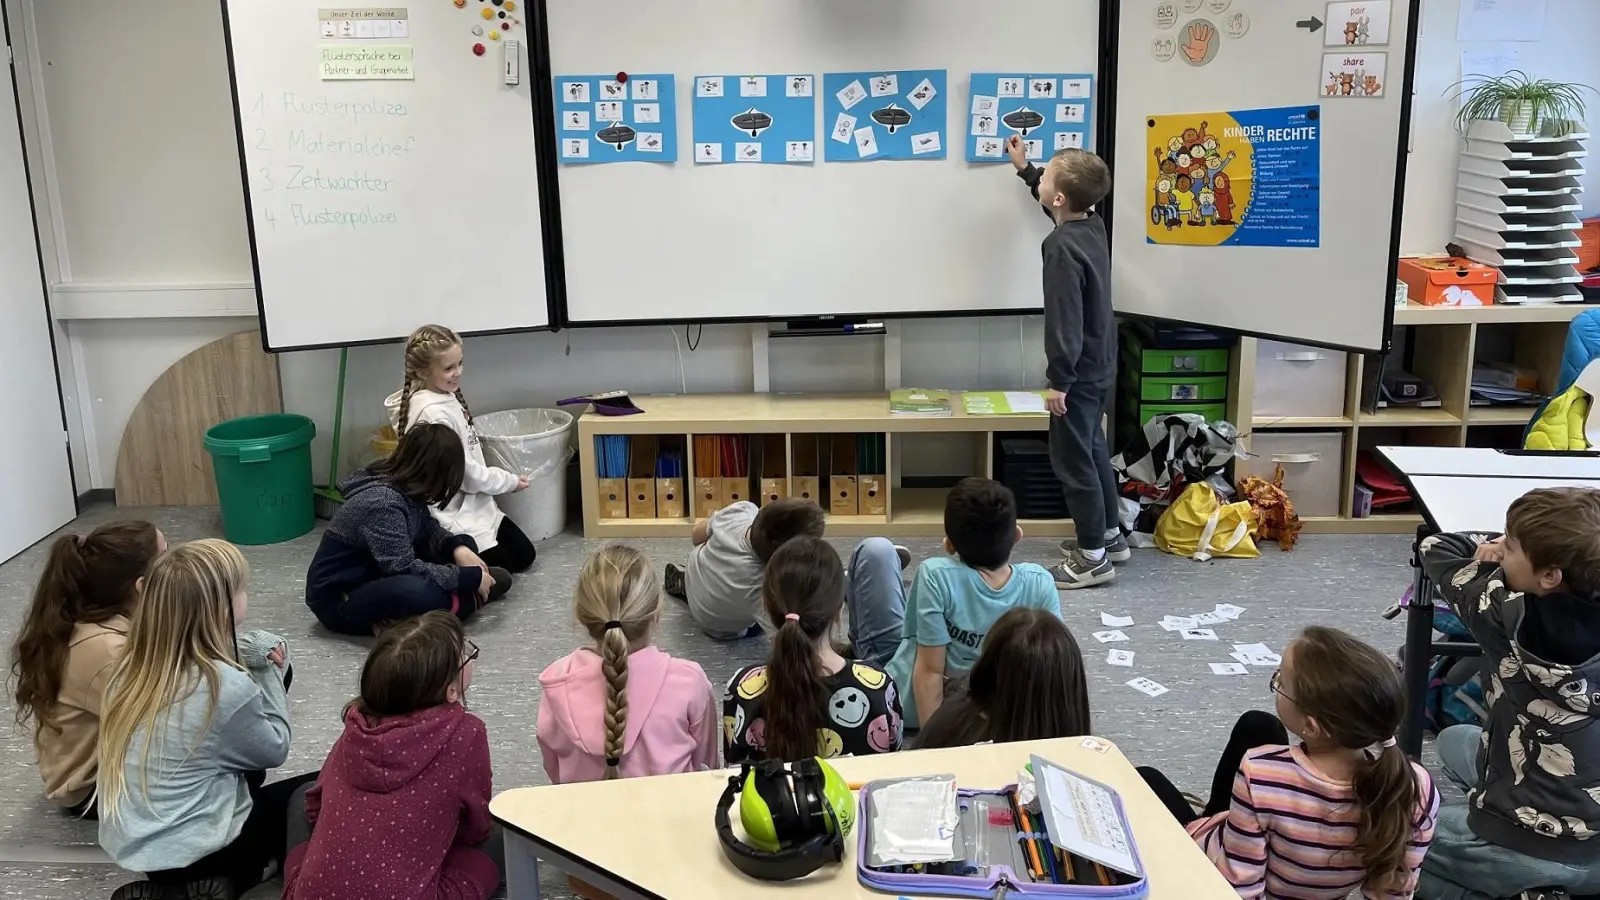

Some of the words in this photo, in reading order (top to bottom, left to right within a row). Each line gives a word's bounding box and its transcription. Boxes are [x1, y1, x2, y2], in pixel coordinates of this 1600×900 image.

[350, 10, 362, 18] Ziel
[376, 10, 395, 18] Woche
[1350, 6, 1366, 17] pair
[388, 51, 401, 60] bei
[1342, 57, 1365, 66] share
[1223, 125, 1264, 138] KINDER
[1267, 126, 1316, 142] RECHTE
[289, 129, 416, 156] Materialchef
[1239, 136, 1265, 144] HABEN
